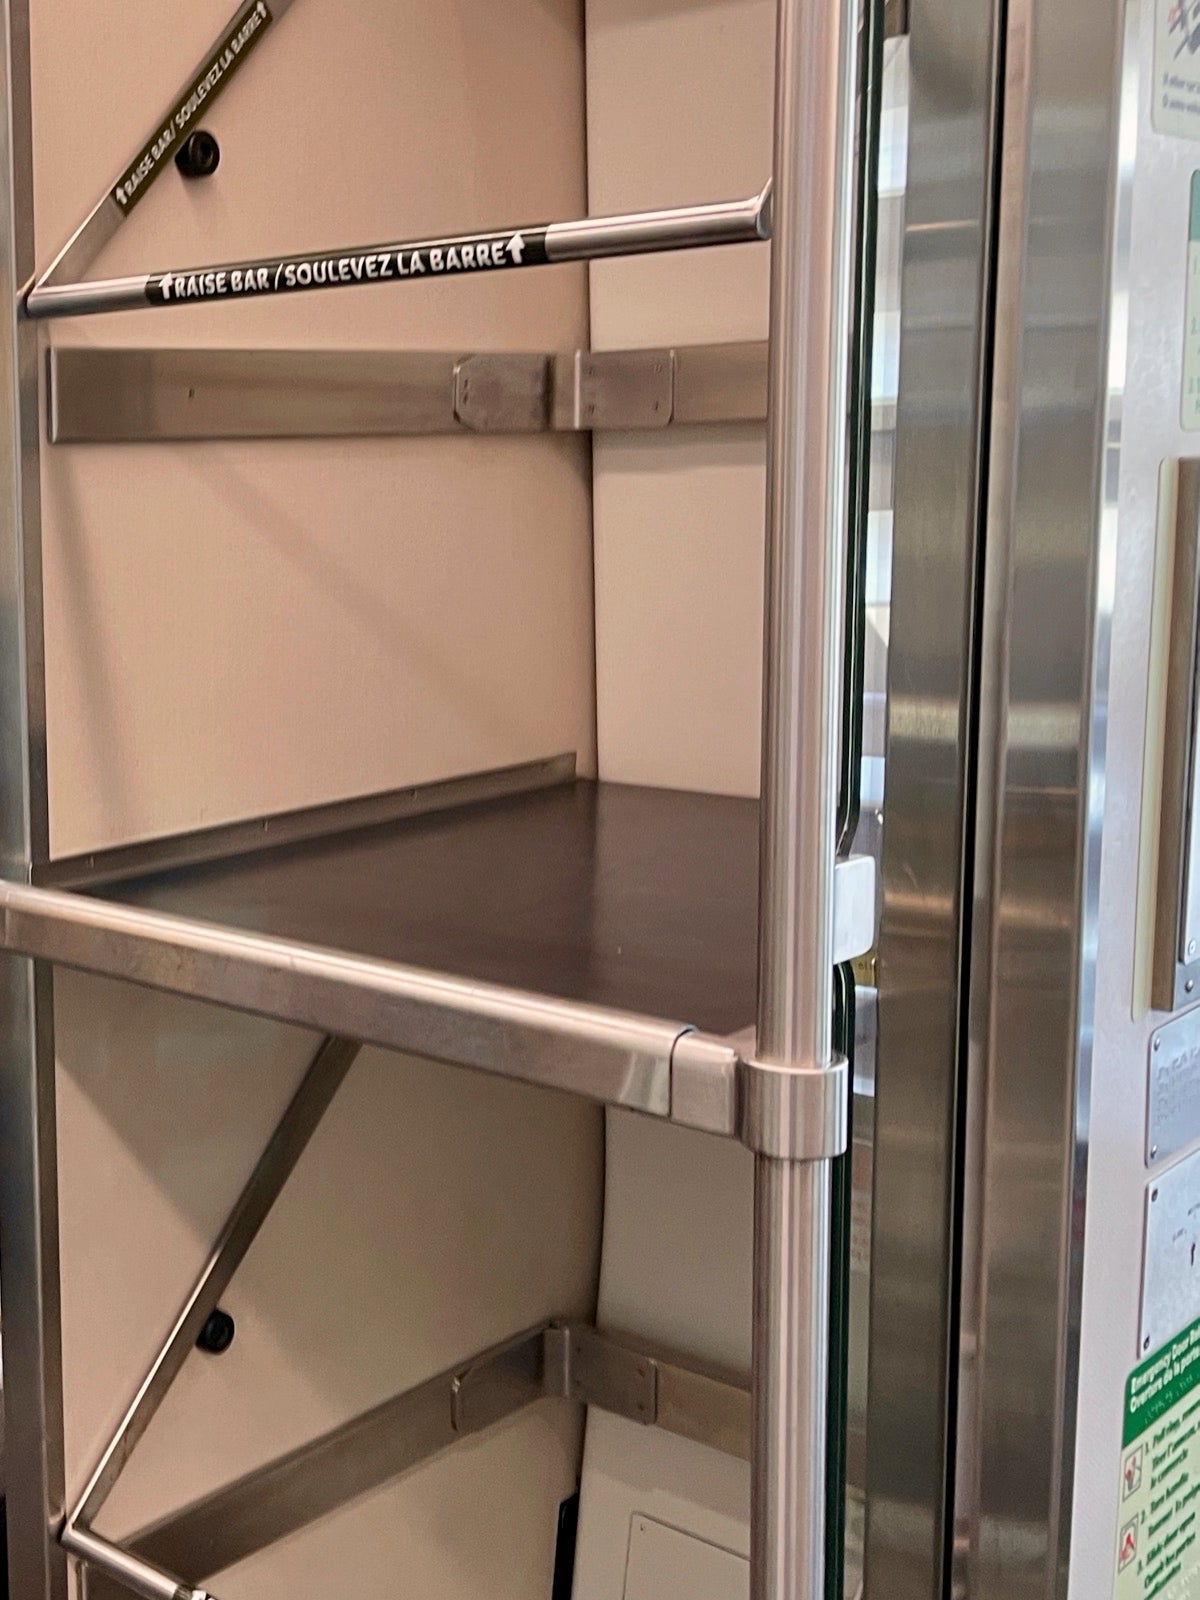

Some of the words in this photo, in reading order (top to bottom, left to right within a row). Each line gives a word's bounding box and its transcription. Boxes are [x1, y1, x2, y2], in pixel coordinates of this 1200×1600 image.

[125, 155, 154, 196] RAISE
[175, 62, 223, 128] SOULEVEZ
[219, 48, 234, 68] LA
[231, 11, 261, 53] BARRE
[175, 272, 227, 298] RAISE
[231, 267, 270, 292] BAR
[397, 250, 426, 275] LA
[430, 241, 506, 272] BARRE
[1131, 1350, 1172, 1395] Emergency
